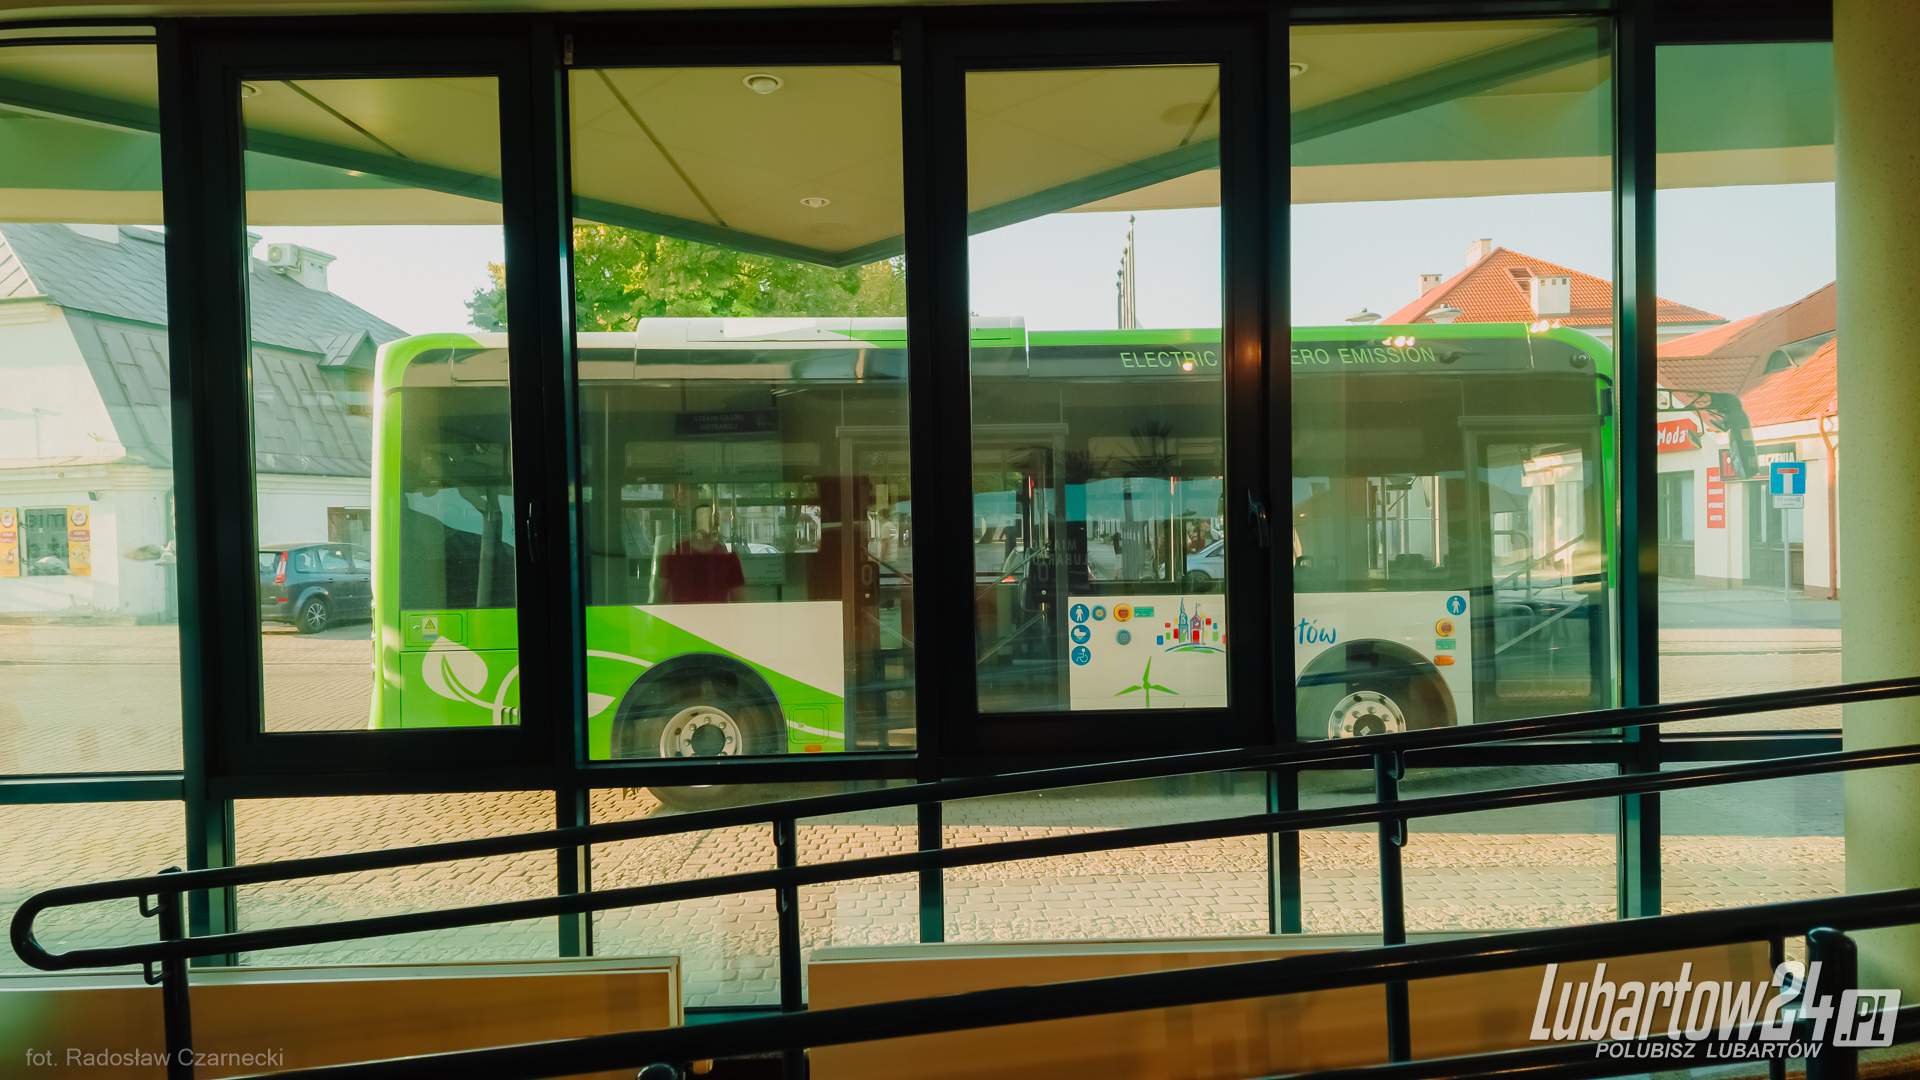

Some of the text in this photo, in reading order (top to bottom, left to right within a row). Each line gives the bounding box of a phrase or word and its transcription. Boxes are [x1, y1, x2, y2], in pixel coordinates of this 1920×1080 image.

[1120, 346, 1436, 368] ELECTRIC ERO EMISSION
[1294, 617, 1337, 645] tów
